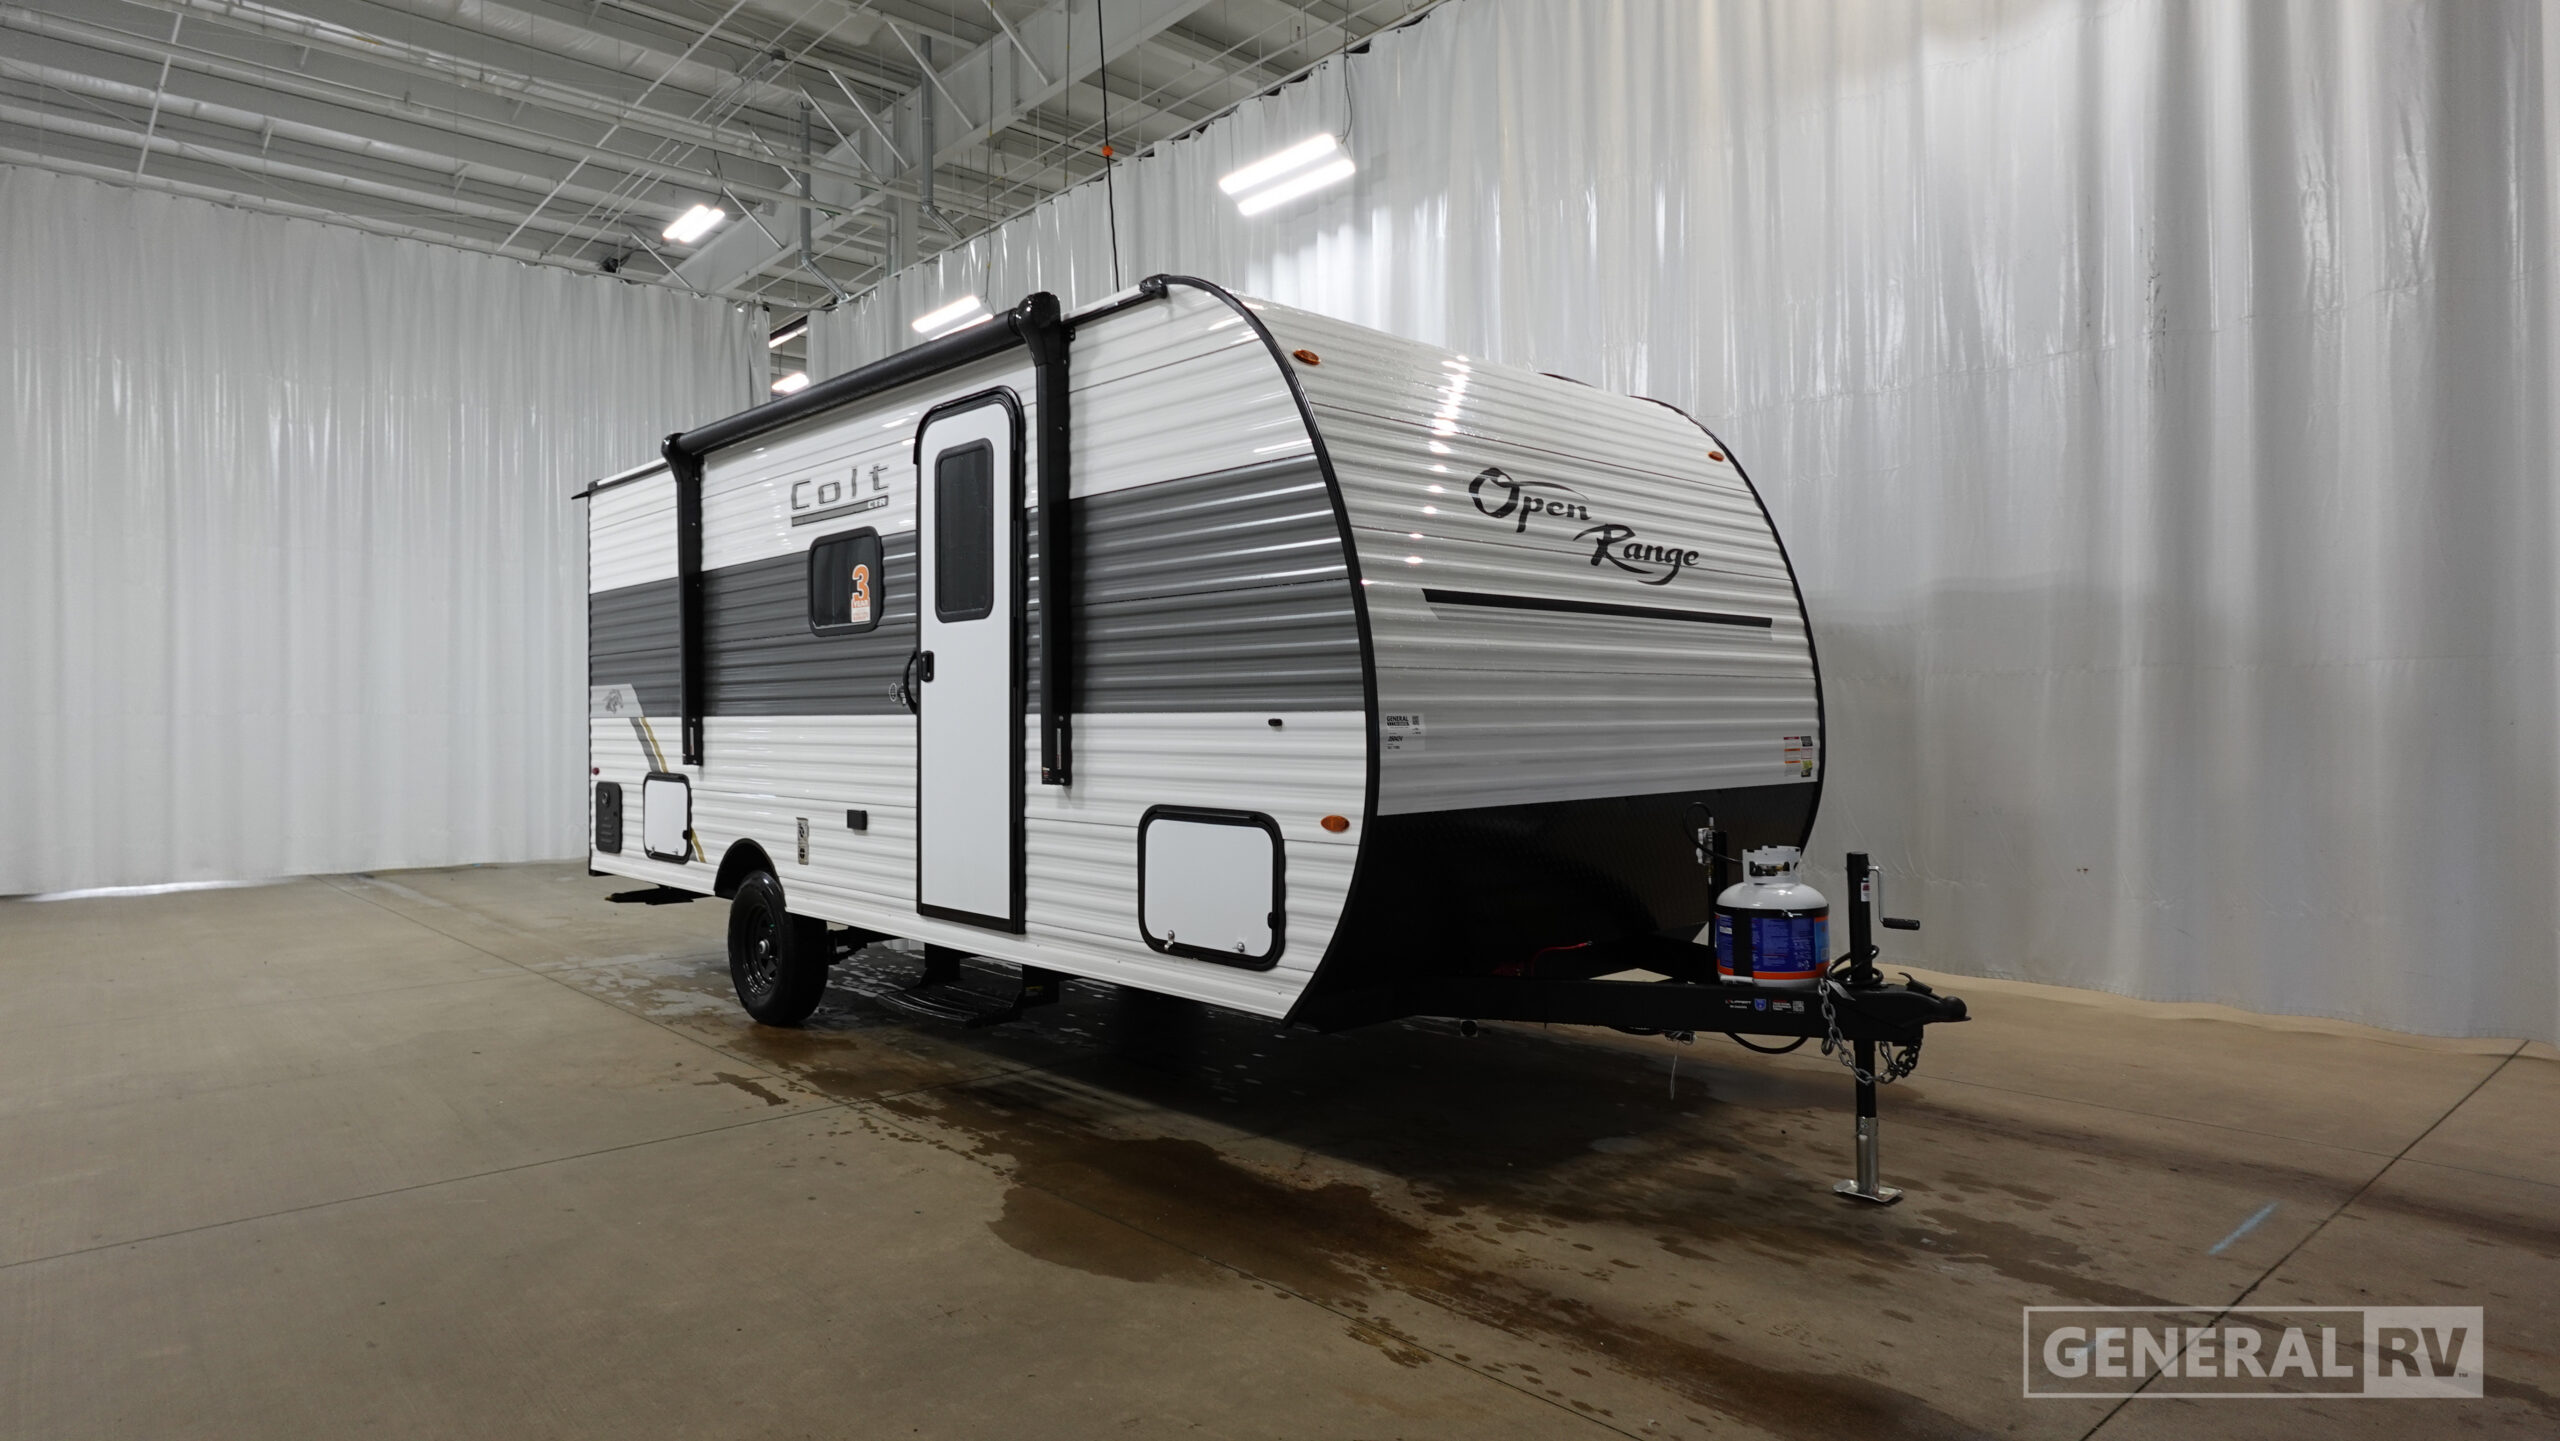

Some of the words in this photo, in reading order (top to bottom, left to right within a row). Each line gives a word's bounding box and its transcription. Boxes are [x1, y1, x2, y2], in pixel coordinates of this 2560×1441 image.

[791, 465, 889, 510] Colt
[1469, 467, 1592, 533] Open
[1573, 523, 1699, 586] Range
[852, 564, 870, 600] 3
